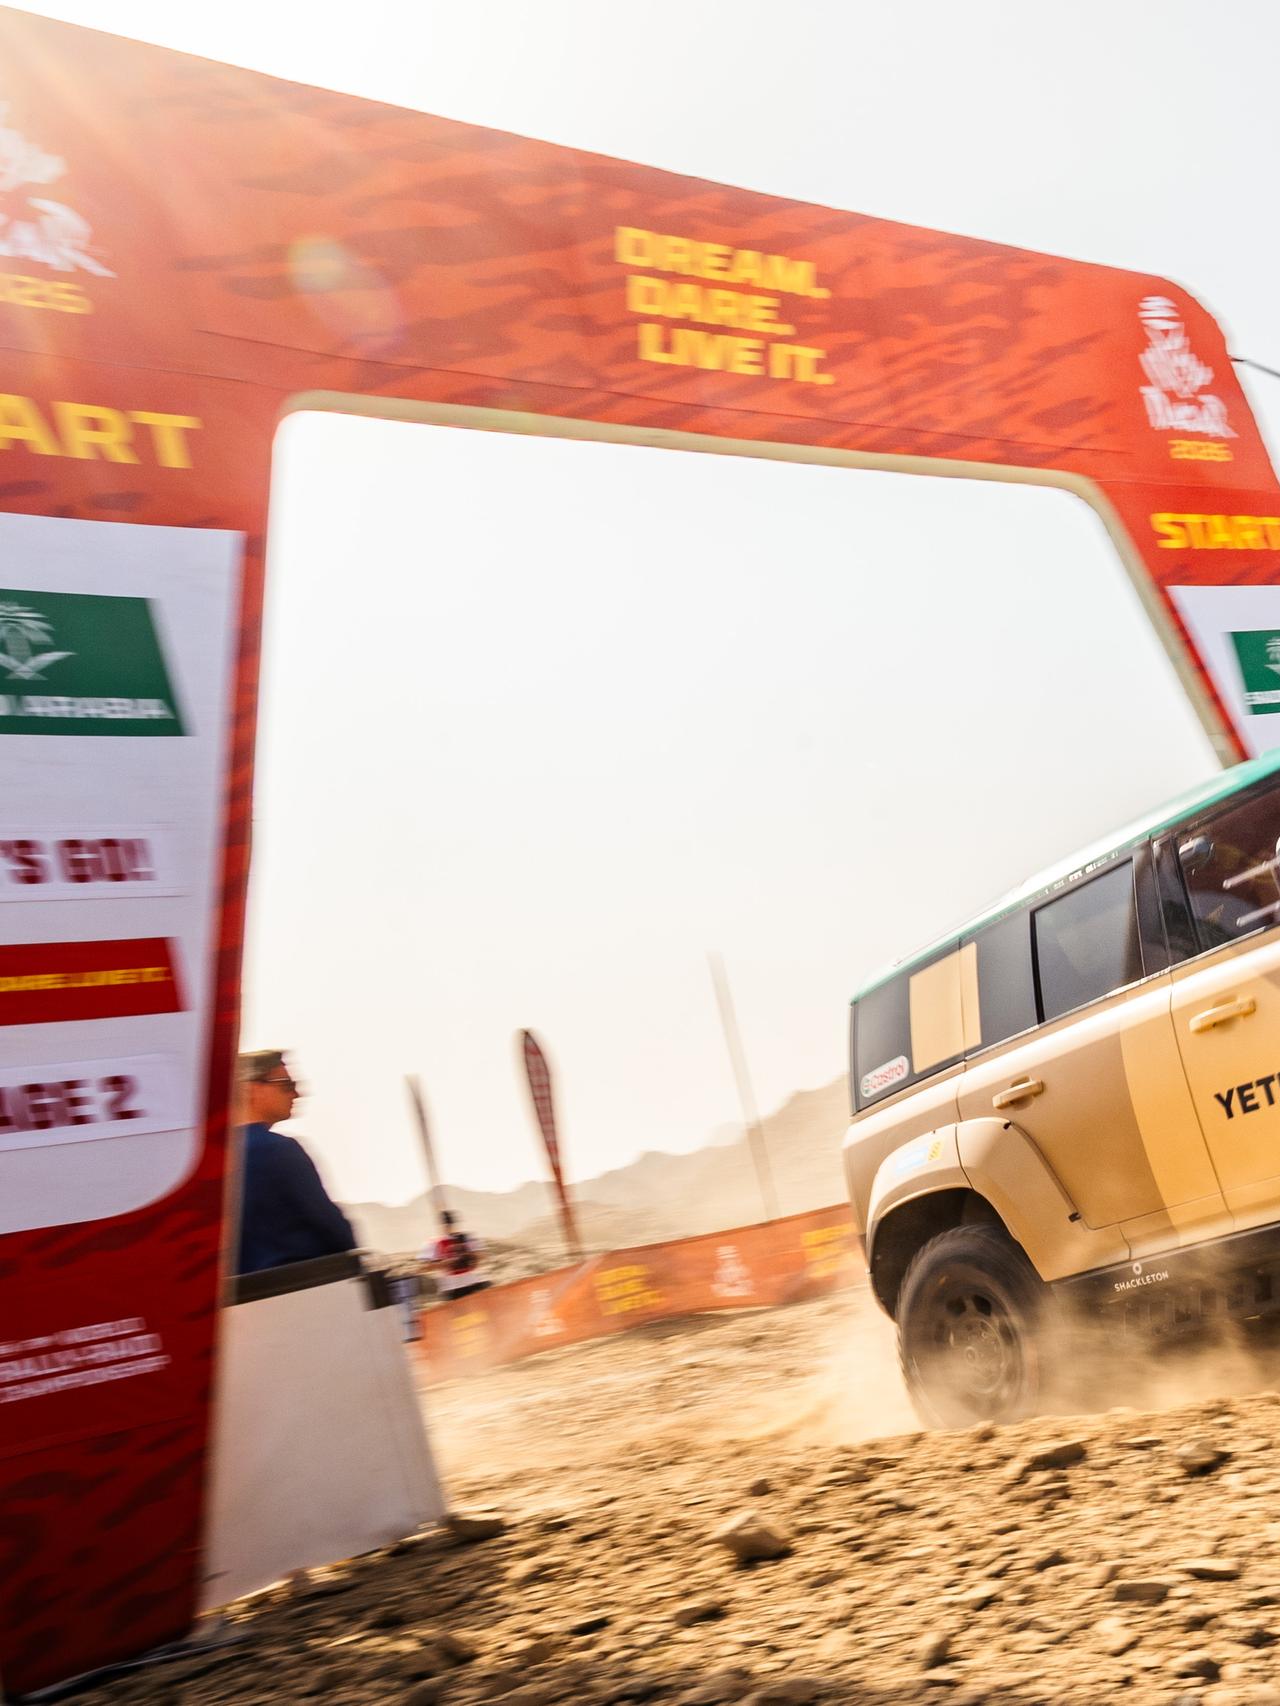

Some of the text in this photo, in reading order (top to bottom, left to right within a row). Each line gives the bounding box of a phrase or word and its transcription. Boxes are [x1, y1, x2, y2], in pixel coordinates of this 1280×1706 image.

[614, 226, 832, 299] DREAM.
[625, 274, 797, 335] DARE.
[637, 323, 766, 375] LIVE
[98, 1075, 147, 1121] 2
[1114, 1270, 1169, 1292] SHACKLETON
